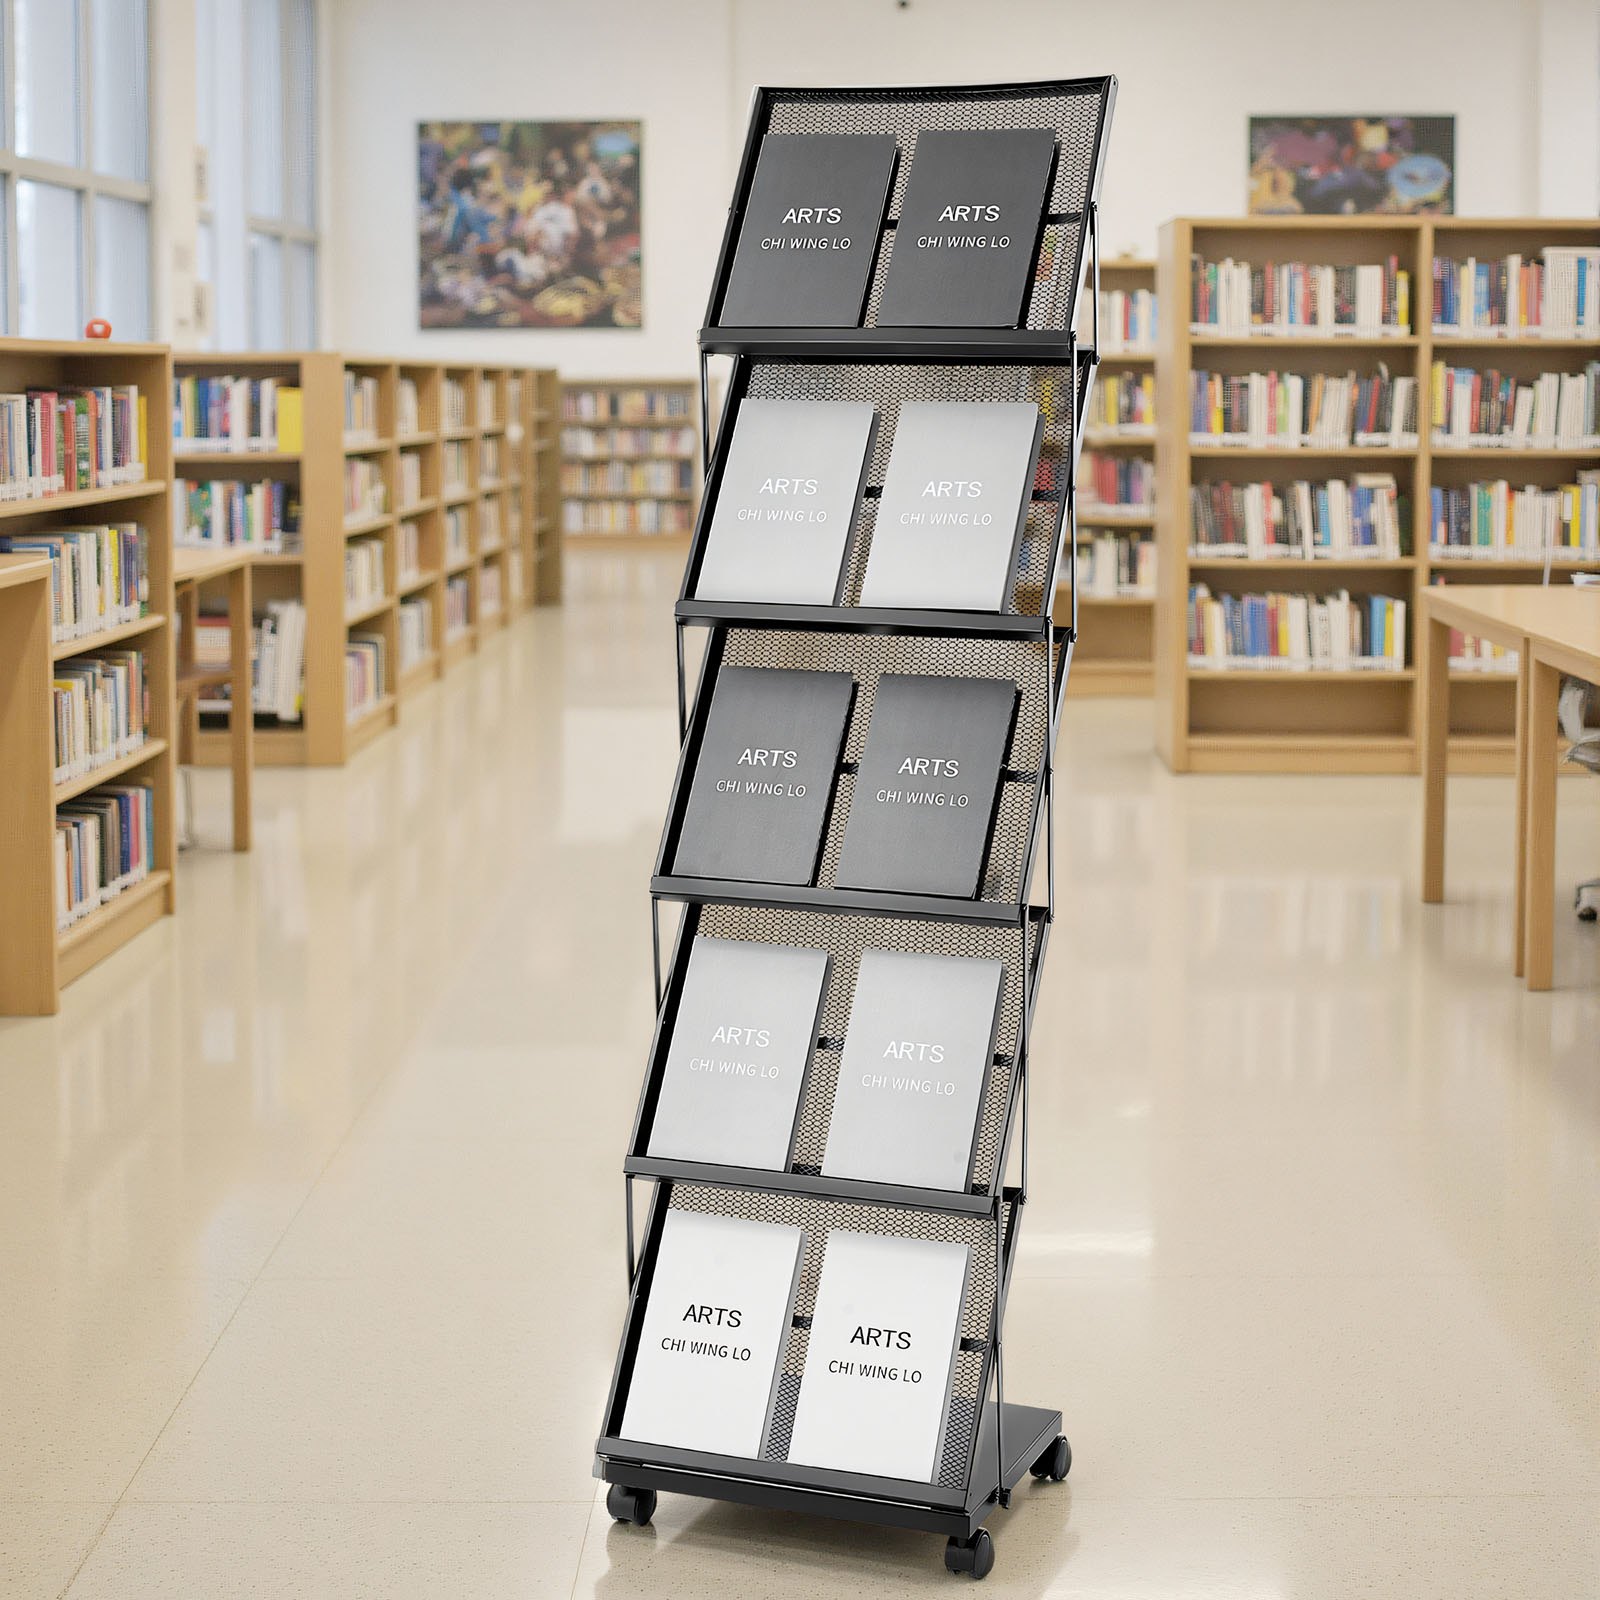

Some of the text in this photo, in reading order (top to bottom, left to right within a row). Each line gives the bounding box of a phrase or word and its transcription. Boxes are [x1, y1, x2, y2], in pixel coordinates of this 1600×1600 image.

[782, 208, 841, 223] ARTS
[938, 206, 999, 221] ARTS
[762, 238, 850, 249] CHI WING LO
[918, 237, 1009, 248] CHI WING LO
[760, 479, 818, 494] ARTS
[922, 481, 982, 497] ARTS
[738, 509, 826, 522] CHI WING LO
[900, 513, 992, 525] CHI WING LO
[738, 749, 797, 767] ARTS
[898, 758, 958, 777] ARTS
[716, 781, 805, 797] CHI WING LO
[877, 790, 968, 807] CHI WING LO
[712, 1026, 770, 1047] ARTS
[883, 1041, 944, 1062] ARTS
[690, 1058, 778, 1078] CHI WING LO
[862, 1074, 954, 1095] CHI WING LO
[683, 1304, 741, 1327] ARTS
[850, 1326, 911, 1349] ARTS
[661, 1338, 751, 1361] CHI WING LO
[829, 1360, 921, 1383] CHI WING LO
